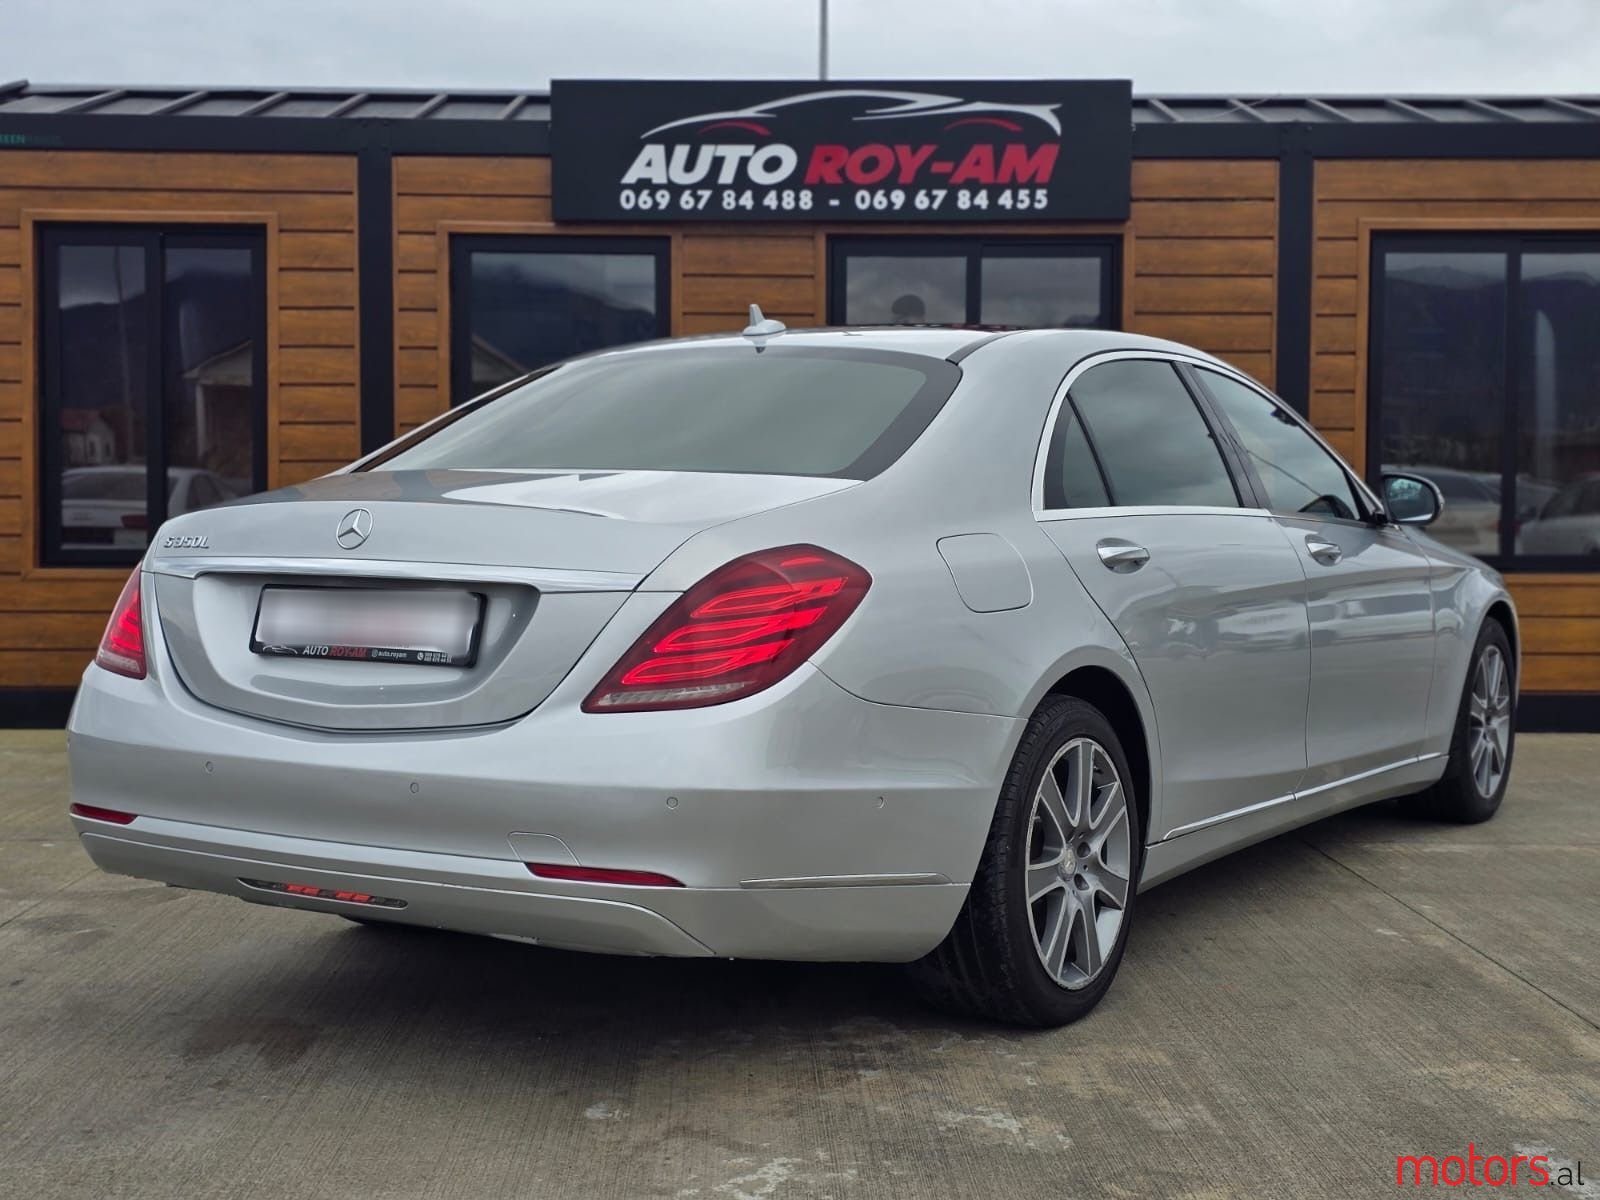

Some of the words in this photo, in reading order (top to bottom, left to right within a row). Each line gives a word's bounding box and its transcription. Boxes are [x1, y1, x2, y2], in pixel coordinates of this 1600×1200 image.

[620, 143, 798, 185] AUTO
[804, 143, 1060, 185] ROY-AM
[619, 189, 671, 211] 069
[679, 189, 713, 211] 67
[722, 189, 755, 211] 84
[762, 189, 814, 211] 488
[854, 189, 906, 211] 069
[915, 189, 948, 211] 67
[956, 189, 990, 211] 84
[998, 189, 1049, 211] 455
[164, 535, 210, 549] S350L
[302, 645, 329, 656] AUTO
